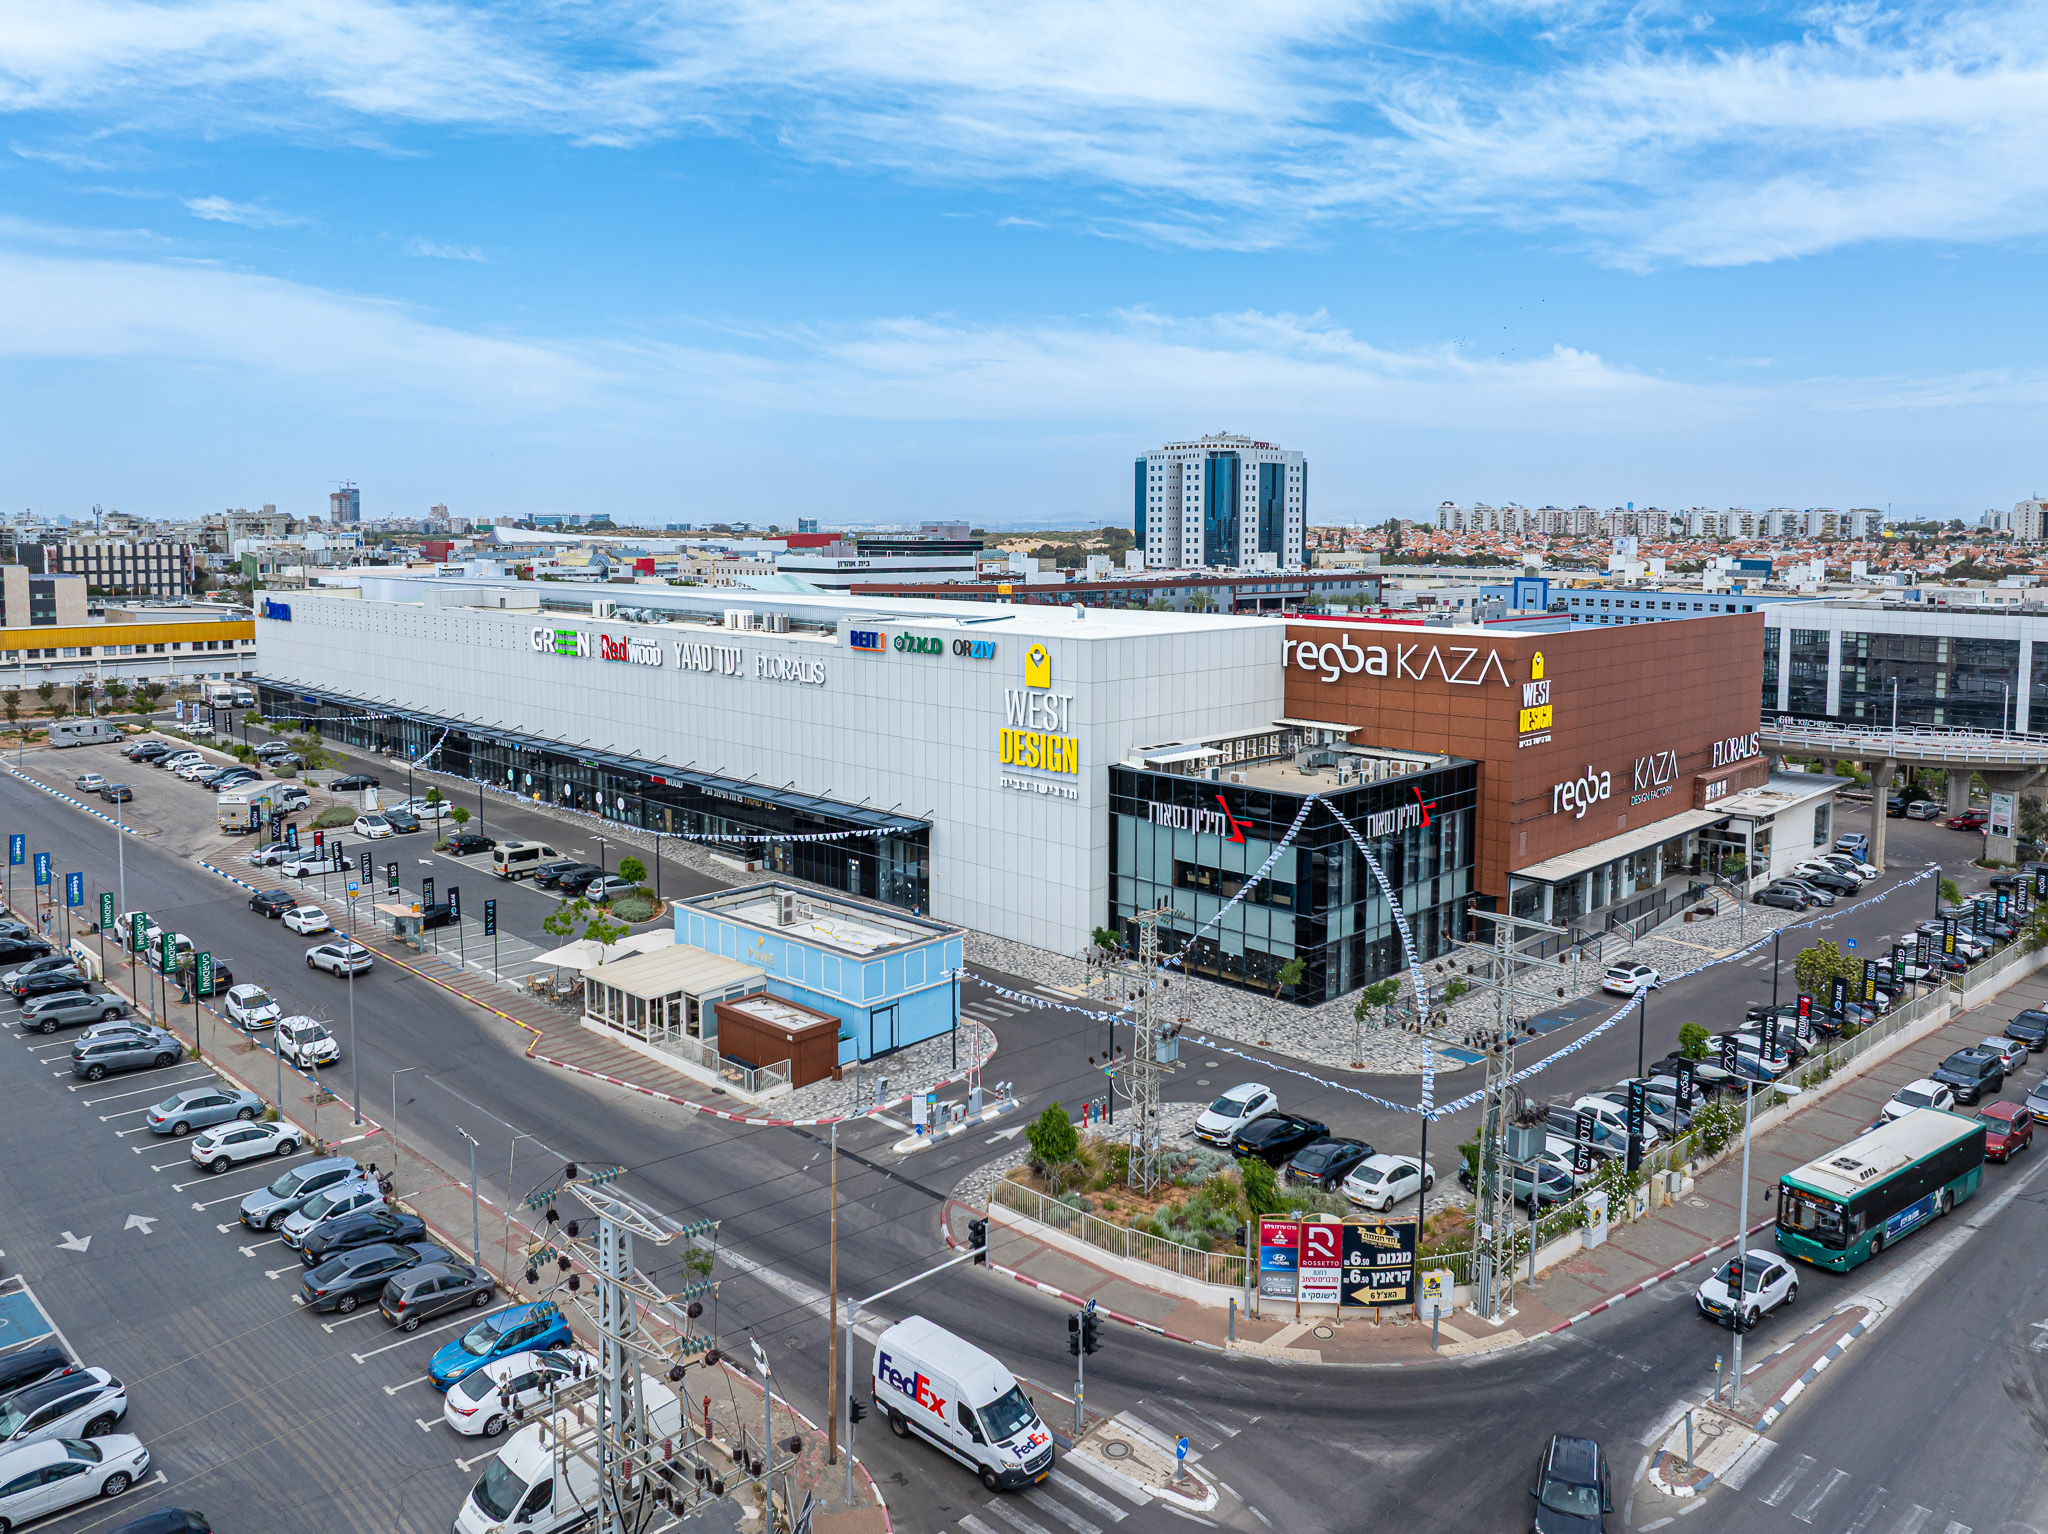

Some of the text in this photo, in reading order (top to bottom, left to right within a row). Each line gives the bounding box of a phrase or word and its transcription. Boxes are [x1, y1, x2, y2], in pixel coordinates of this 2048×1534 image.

[531, 626, 591, 658] GREEN
[850, 630, 878, 649] REIT
[754, 655, 826, 684] FLORALIS
[1282, 633, 1388, 682] regba
[1397, 643, 1510, 688] KAZA
[1004, 688, 1073, 733] WEST
[1522, 680, 1552, 708] WEST
[1519, 704, 1553, 733] DESIGN
[999, 727, 1078, 775] DESIGN
[1712, 731, 1759, 768] FLORALIS
[1633, 749, 1679, 791] KAZA
[1000, 776, 1078, 800] תרגישו בבית
[1553, 765, 1611, 819] regba
[1630, 784, 1673, 806] DESIGN FACTORY
[1148, 801, 1226, 837] כסאות מיליון
[1366, 803, 1420, 839] מיליון כסאות
[136, 914, 145, 946] GARDINI
[1945, 919, 1955, 953] WEST DESIGN
[167, 934, 176, 969] GARDINI
[748, 947, 774, 965] PANE
[1895, 948, 1905, 983] GREEN
[202, 953, 210, 989] GARDINI
[1865, 963, 1876, 1000] WEST DESIGN
[1763, 1016, 1774, 1059] רהיטי געש
[1681, 1069, 1691, 1099] regba
[1632, 1096, 1642, 1134] PANE
[1376, 1251, 1412, 1265] מגנום
[1308, 1292, 1337, 1300] לישנסקי
[1371, 1270, 1411, 1287] קראנץ
[878, 1350, 947, 1420] FedEx
[1011, 1432, 1050, 1460] FedEx
